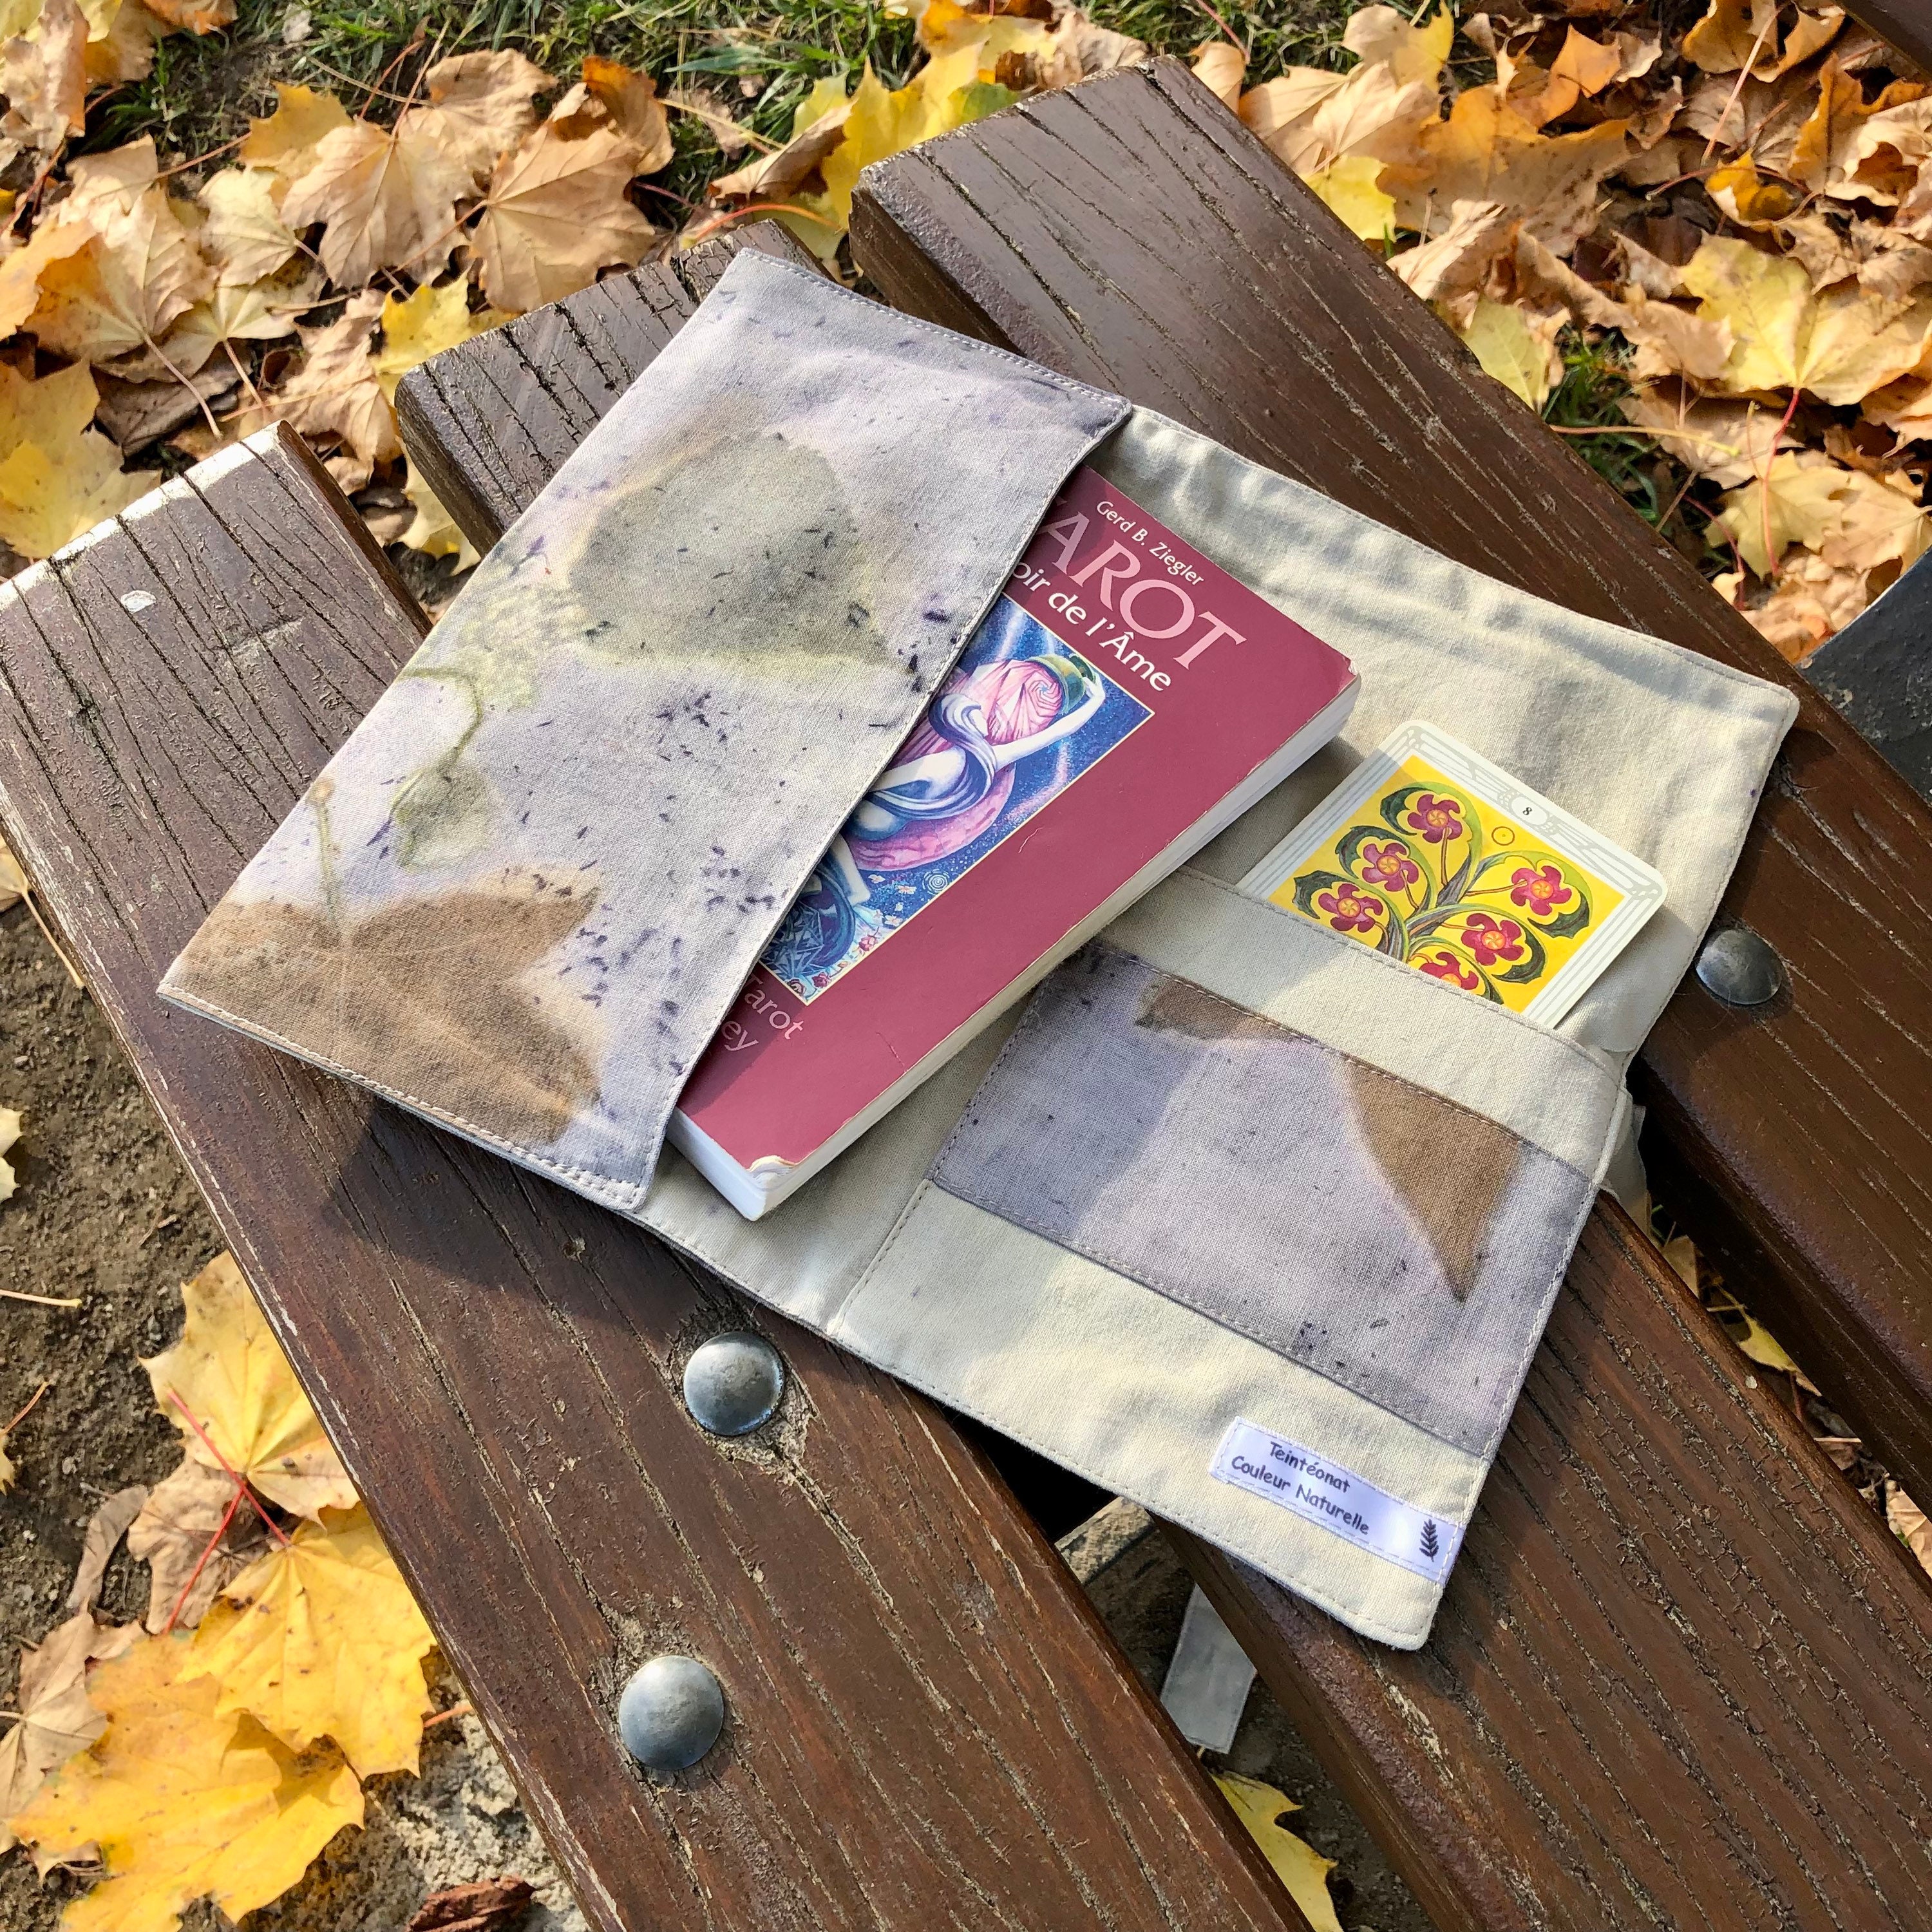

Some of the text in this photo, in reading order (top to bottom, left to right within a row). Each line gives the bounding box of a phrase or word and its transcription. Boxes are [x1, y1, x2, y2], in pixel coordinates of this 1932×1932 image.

[1096, 500, 1204, 586] Gerd B. Ziegler
[1036, 496, 1247, 670] AROT
[1048, 590, 1087, 625] de
[1085, 617, 1173, 692] l'Âme
[1522, 807, 1532, 815] 8
[721, 1010, 759, 1052] ey
[743, 972, 804, 1039] Tarot
[1231, 1455, 1370, 1536] Couleur Naturelle
[1269, 1441, 1351, 1493] Teintéonat
